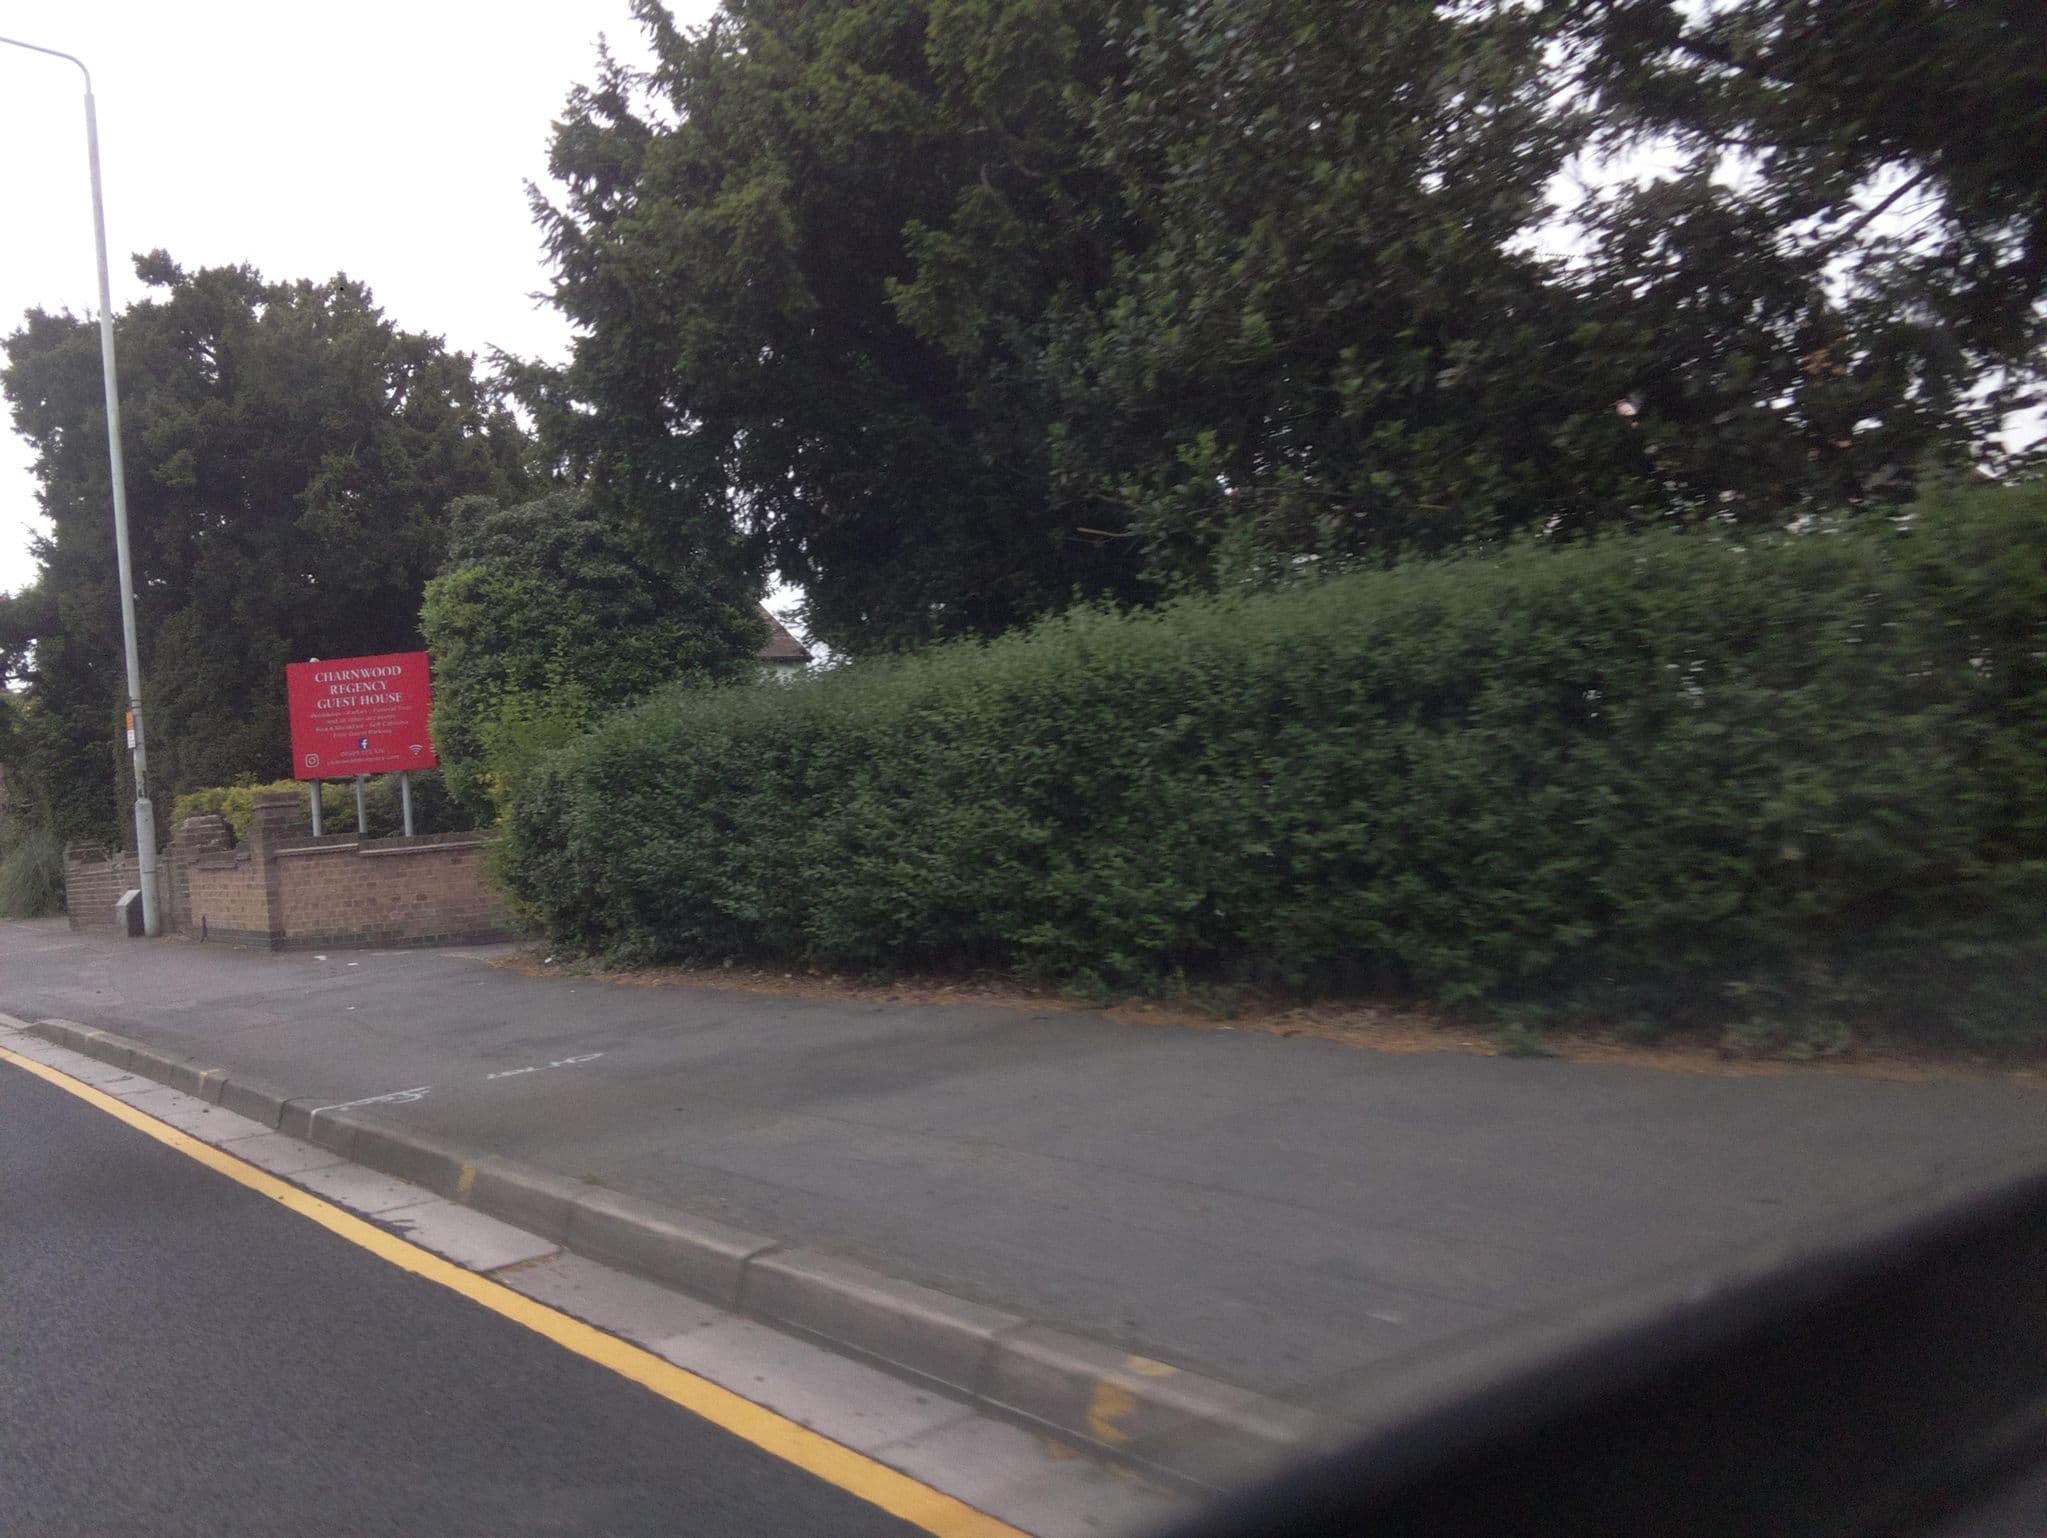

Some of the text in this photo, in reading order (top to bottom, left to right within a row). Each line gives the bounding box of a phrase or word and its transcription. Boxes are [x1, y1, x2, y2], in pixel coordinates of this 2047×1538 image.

[314, 665, 402, 683] CHARNWOOD
[330, 680, 388, 695] REGENCY
[317, 692, 402, 709] GUEST HOUSE
